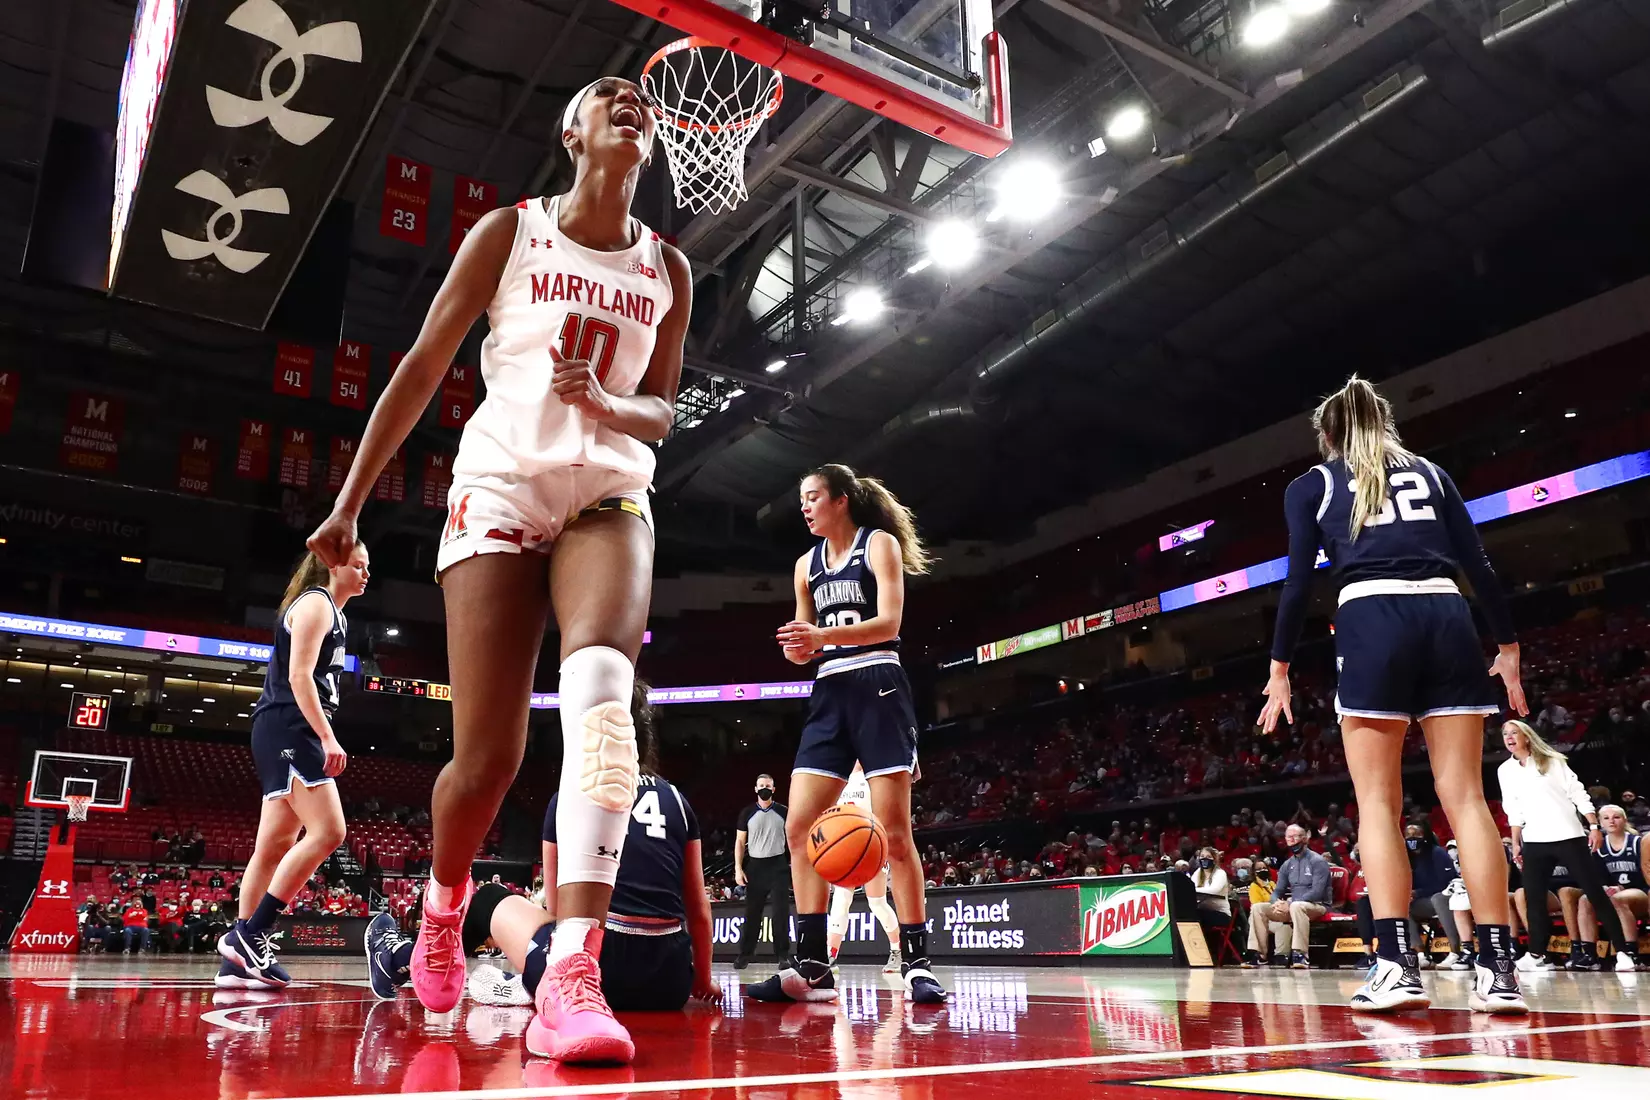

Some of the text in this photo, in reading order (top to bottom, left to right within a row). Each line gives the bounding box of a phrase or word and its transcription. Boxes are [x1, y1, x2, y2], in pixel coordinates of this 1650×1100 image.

[401, 162, 418, 182] M
[468, 182, 484, 201] M
[392, 208, 416, 231] 23
[531, 273, 655, 327] MARYLAND
[345, 344, 360, 359] M
[559, 312, 620, 386] 10
[284, 369, 302, 387] 41
[452, 366, 465, 381] M
[340, 382, 359, 400] 54
[84, 398, 109, 422] M
[452, 404, 461, 419] 6
[70, 425, 114, 442] NATIONAL
[63, 435, 118, 453] CHAMPIONS
[70, 516, 145, 538] center
[218, 643, 248, 656] JUST
[981, 645, 991, 661] M
[369, 682, 379, 690] 38
[76, 707, 100, 726] 20
[944, 898, 1010, 931] planet
[1083, 890, 1166, 952] LIBMAN
[20, 930, 75, 949] xfinity
[952, 922, 1024, 949] fitness
